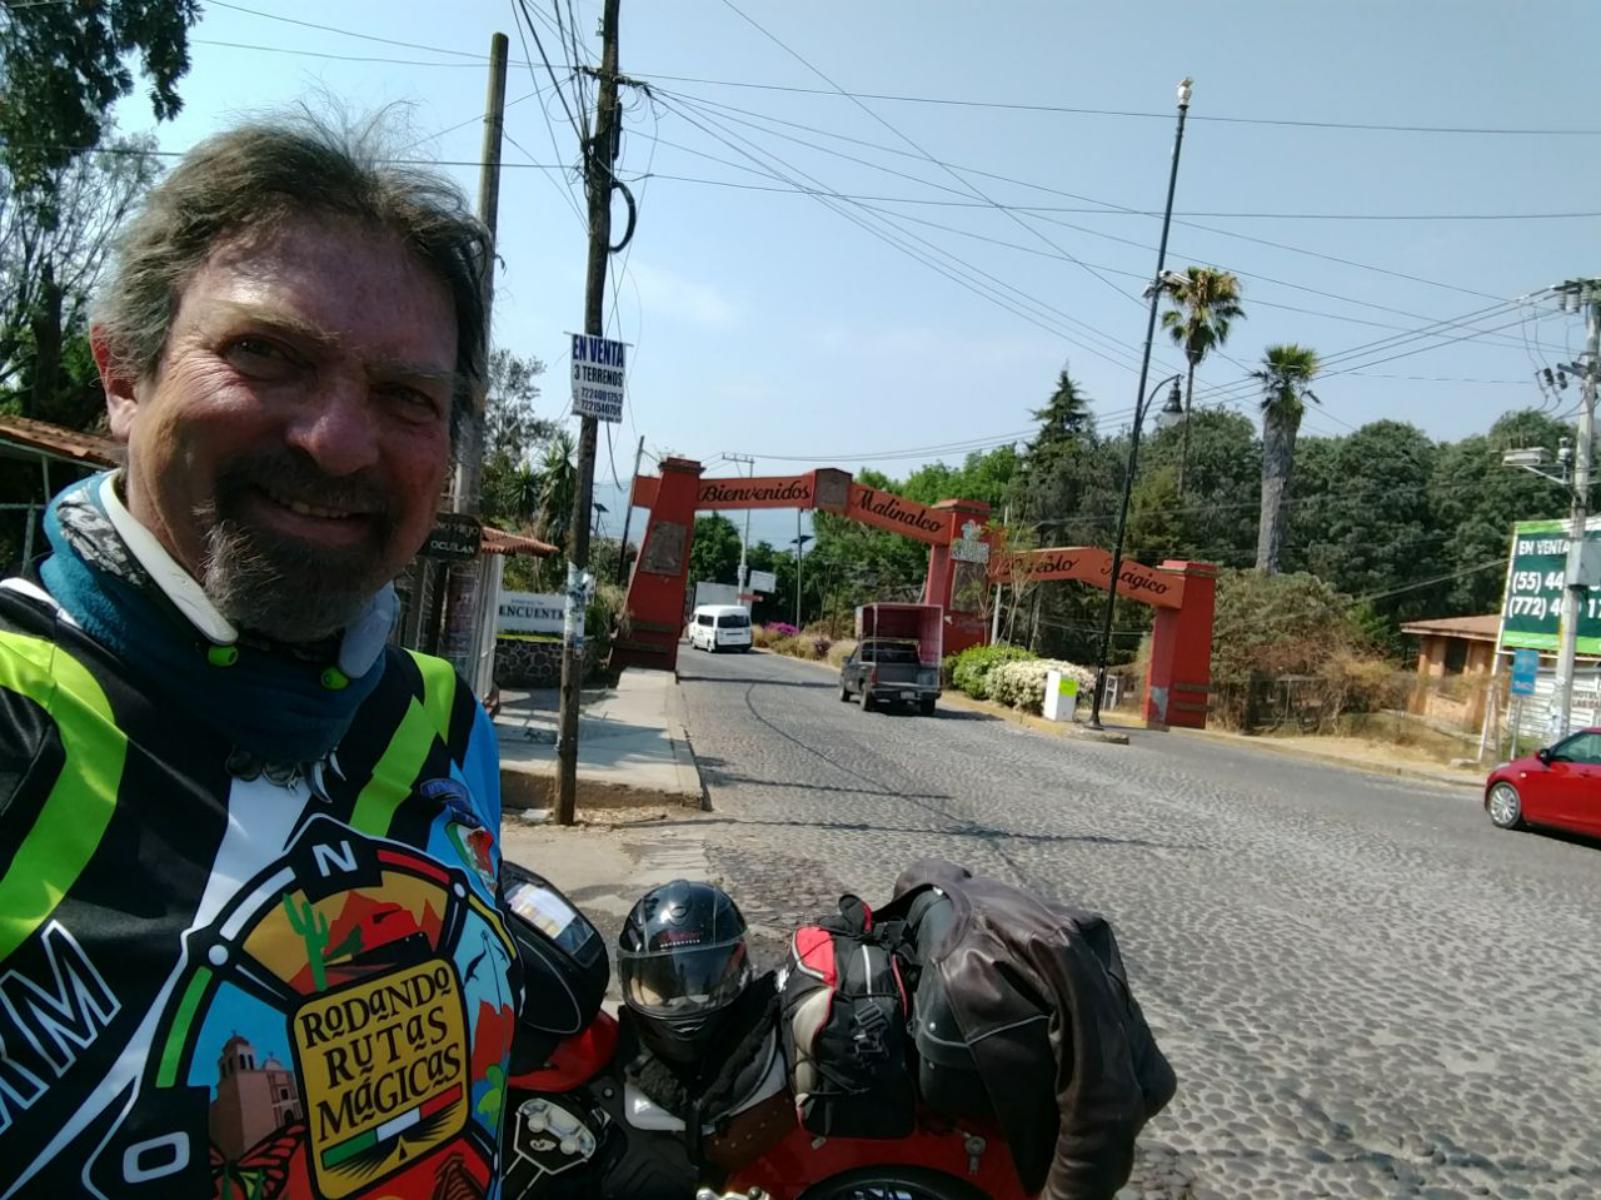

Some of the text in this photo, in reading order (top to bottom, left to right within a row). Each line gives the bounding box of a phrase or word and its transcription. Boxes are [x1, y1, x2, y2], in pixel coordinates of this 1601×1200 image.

[572, 334, 624, 368] EN VENTA
[574, 364, 624, 387] 3 TERRENOS
[700, 480, 811, 502] Bienvenidos
[855, 488, 944, 533] Malinalco
[1518, 539, 1570, 555] EN VENTA
[1512, 571, 1565, 595] (55) 44
[498, 604, 564, 620] ENCUENTR
[1508, 596, 1547, 621] (772)
[312, 840, 358, 877] N
